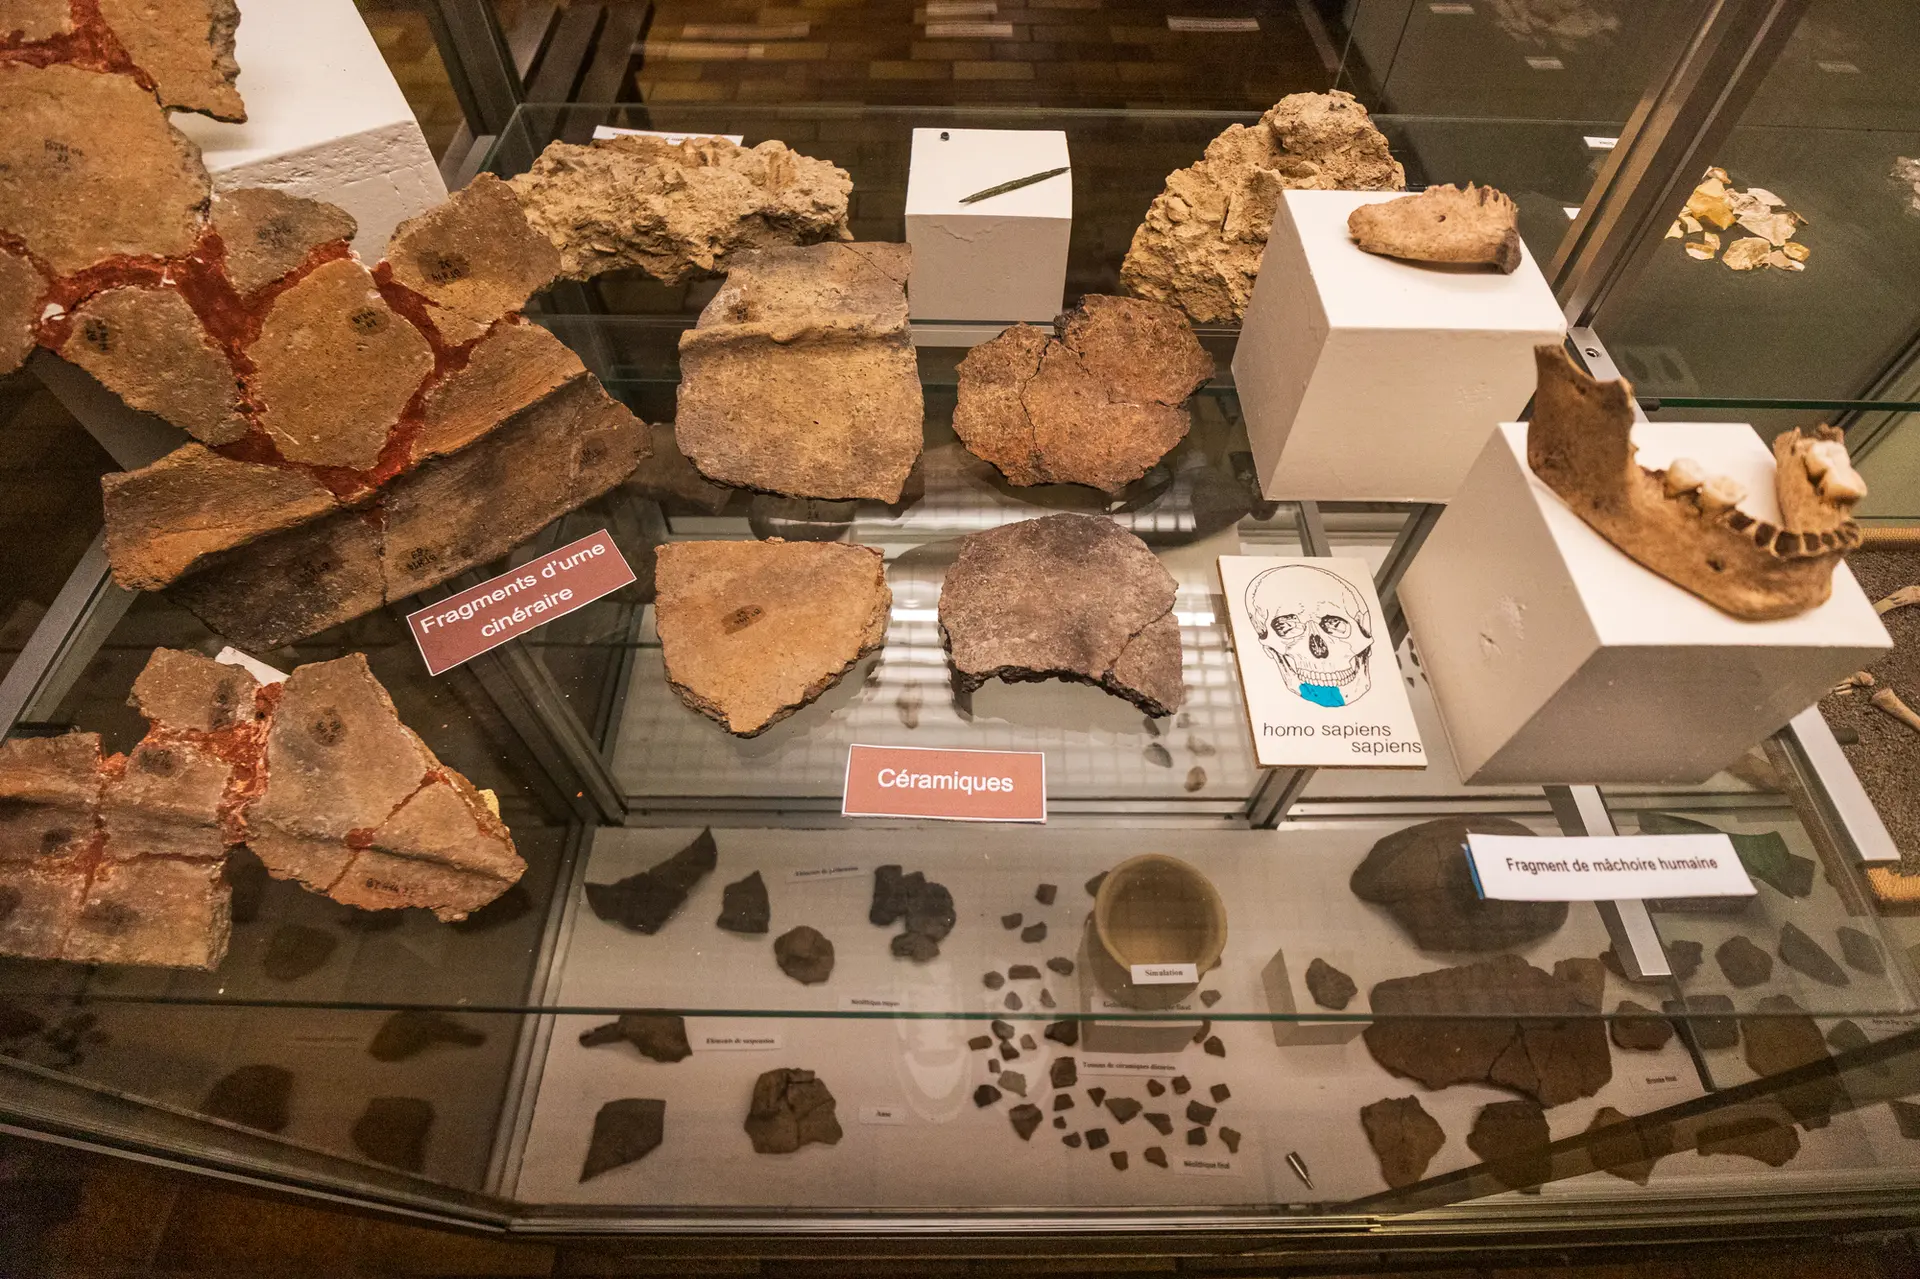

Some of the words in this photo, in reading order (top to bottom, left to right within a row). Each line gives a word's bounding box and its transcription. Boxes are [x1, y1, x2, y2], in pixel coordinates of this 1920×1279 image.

[420, 573, 537, 634] Fragments
[541, 543, 606, 579] d'urne
[481, 587, 574, 638] cinéraire
[1263, 722, 1315, 737] homo
[1321, 722, 1391, 739] sapiens
[1351, 739, 1422, 756] sapiens
[877, 768, 1014, 796] Céramiques
[1505, 857, 1571, 876] Fragment
[1572, 858, 1590, 872] de
[1592, 857, 1657, 872] mâchoire
[1658, 856, 1718, 870] humaine
[1144, 969, 1184, 977] Simulation
